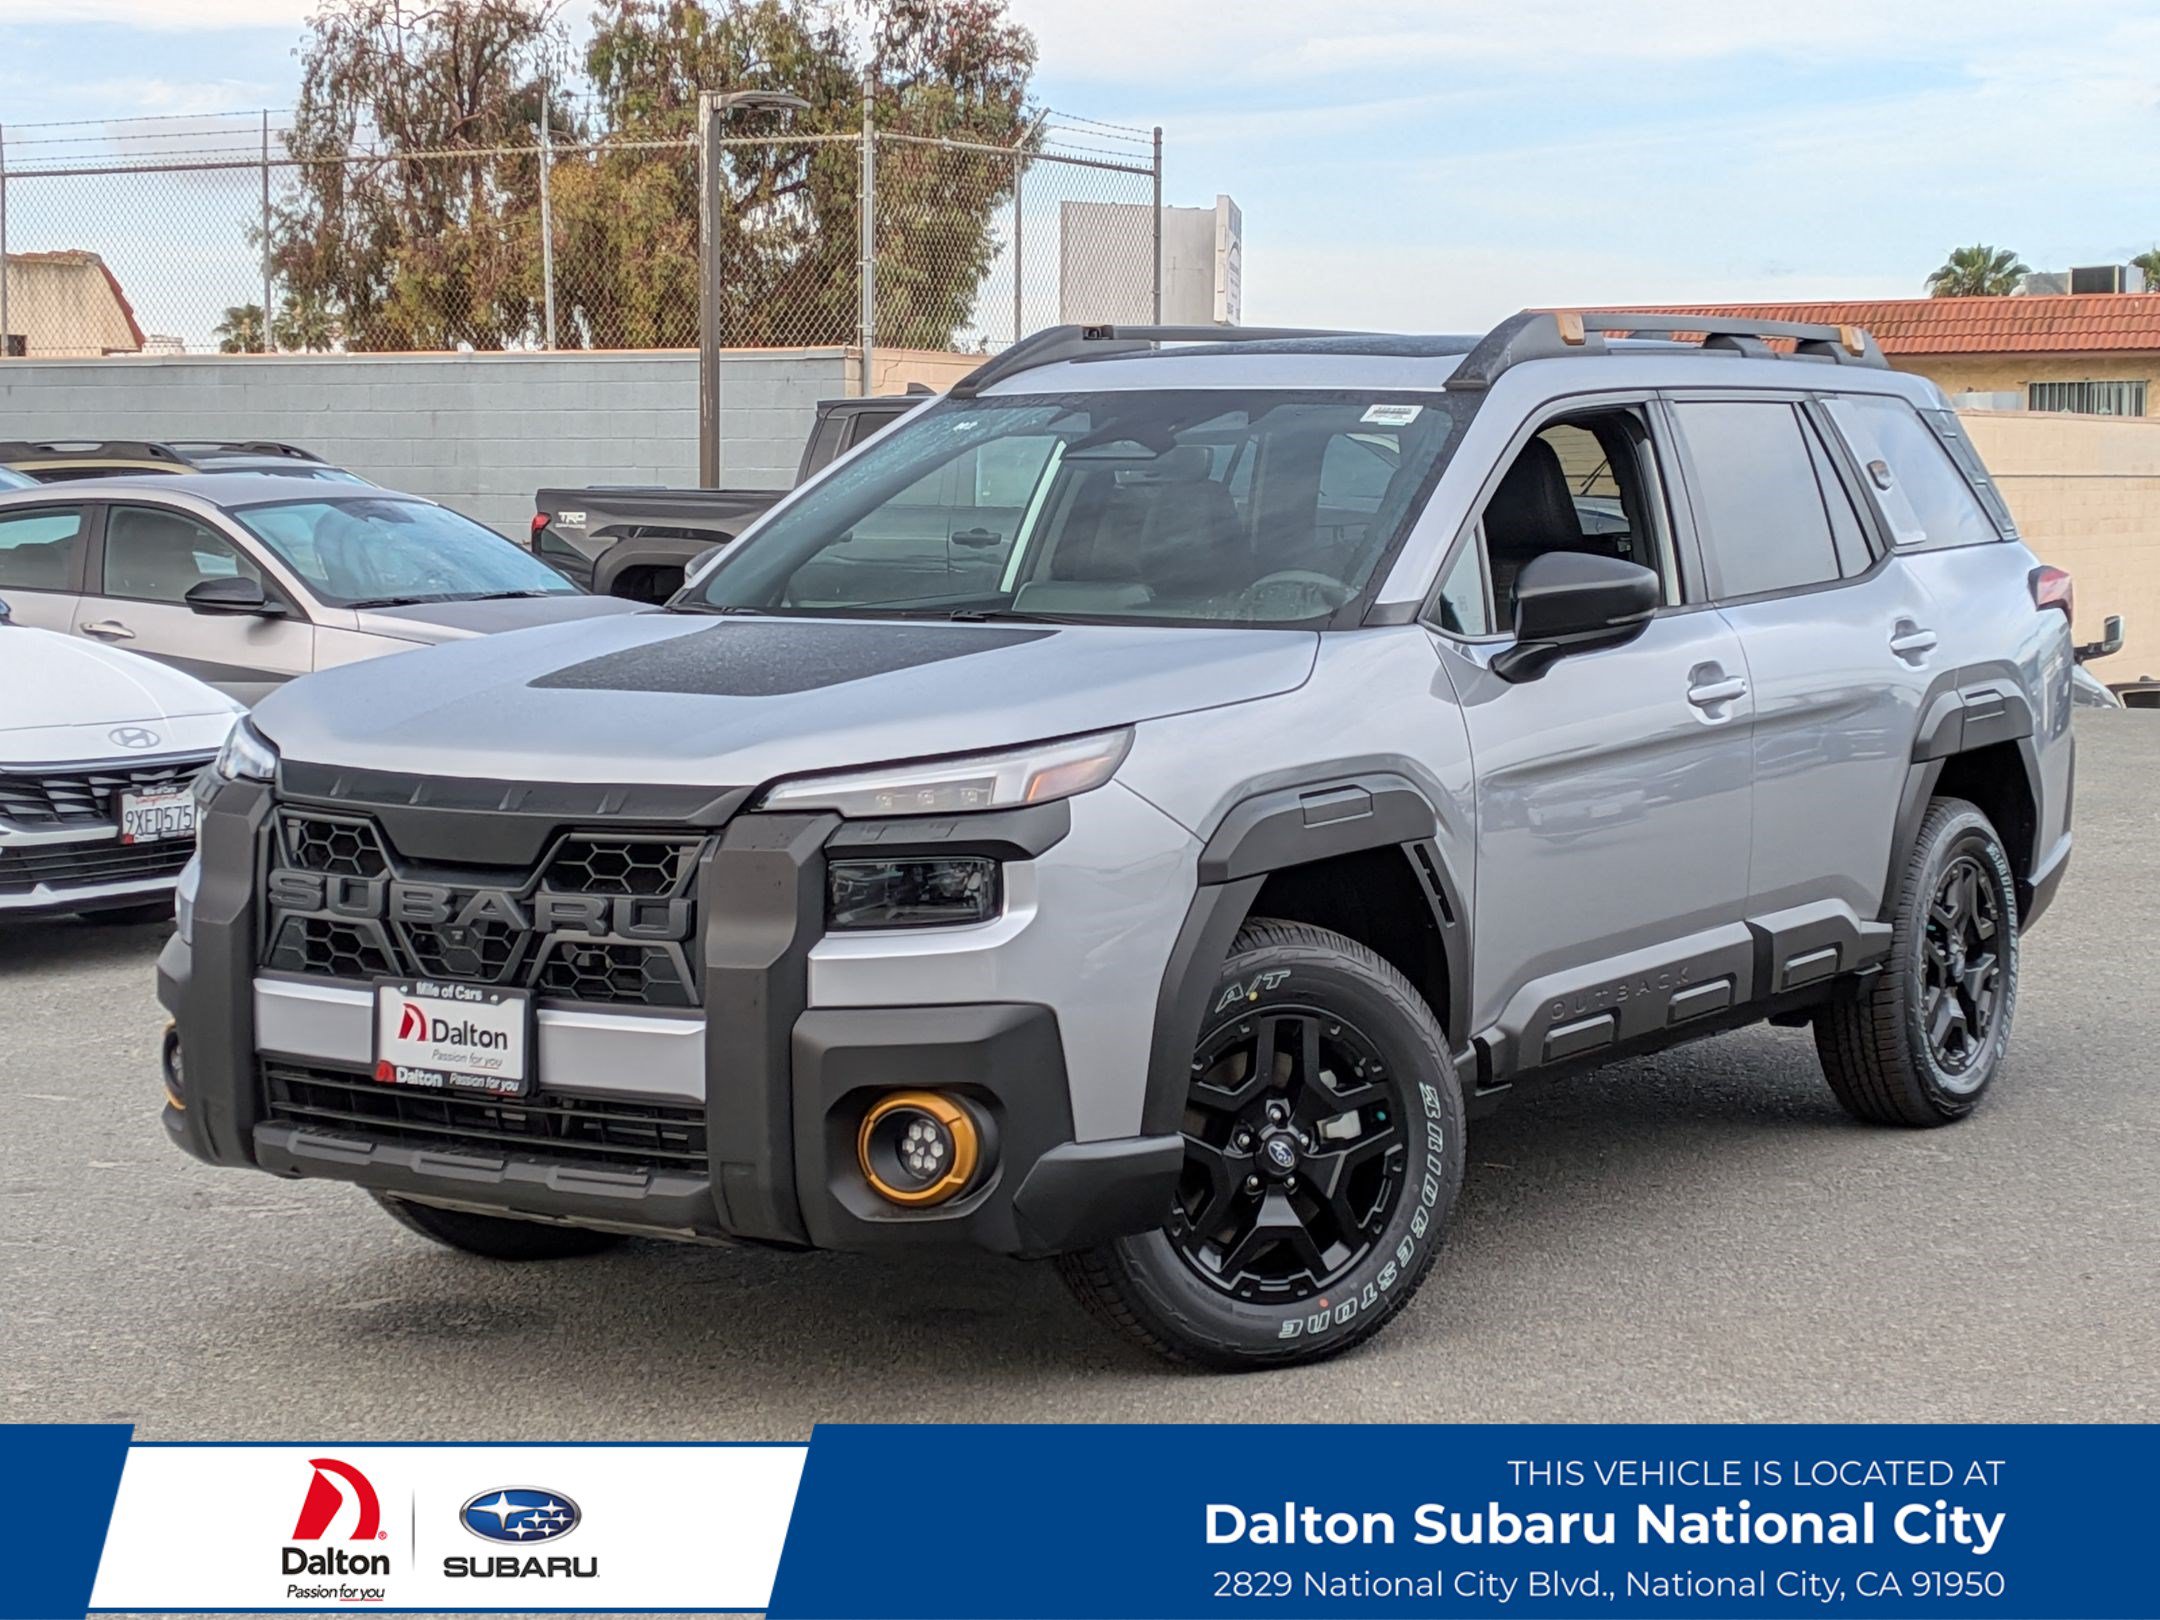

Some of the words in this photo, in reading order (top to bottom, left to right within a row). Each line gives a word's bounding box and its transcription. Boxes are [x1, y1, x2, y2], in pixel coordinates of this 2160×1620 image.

[557, 511, 587, 524] TRD
[268, 868, 695, 942] SUBARU
[416, 982, 440, 997] Mile
[441, 986, 455, 998] of
[455, 986, 483, 1001] Cars
[1214, 969, 1291, 1013] A/T
[1551, 967, 1689, 1020] OUTBACK
[432, 1018, 508, 1050] Dalton
[431, 1049, 468, 1063] Passion
[468, 1054, 484, 1066] for
[483, 1056, 503, 1067] you
[396, 1067, 443, 1088] Dalton
